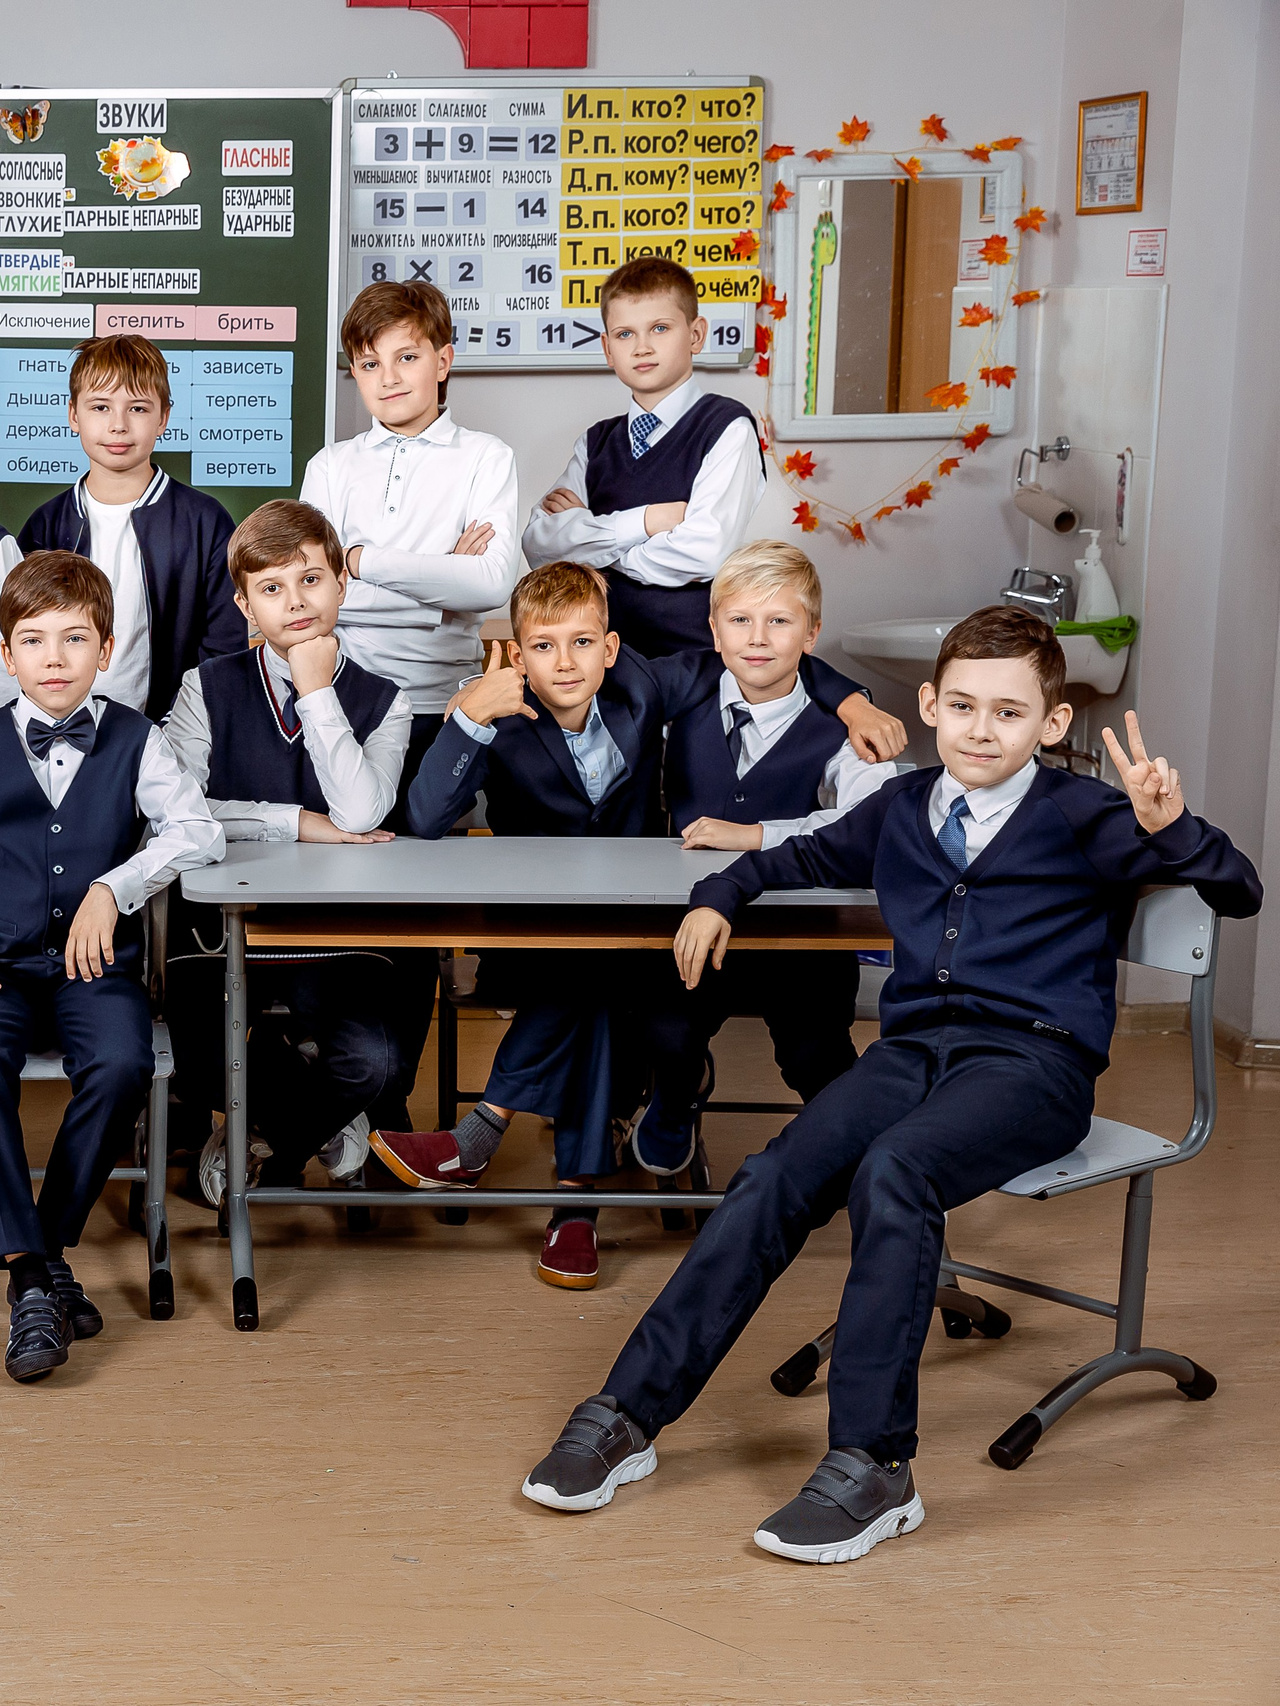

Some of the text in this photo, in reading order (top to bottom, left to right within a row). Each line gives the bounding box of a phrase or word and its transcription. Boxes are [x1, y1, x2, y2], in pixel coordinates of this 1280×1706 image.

[359, 102, 545, 118] СЛАГАЕМОЕ СЛАГАЕМОЕ СУММА
[567, 92, 756, 119] И.п. кто? что?
[99, 104, 164, 128] ЗВУКИ
[384, 134, 399, 153] 3
[528, 134, 556, 153] 12
[624, 130, 688, 154] кого?
[694, 129, 758, 153] чего?
[223, 147, 291, 168] ГЛАСНЫЕ
[0, 161, 63, 181] согласные
[354, 170, 552, 184] УМЕНЬШАЕМОЕ ВЫЧИТАЕМОЕ РАЗНОСТЬ
[568, 162, 759, 193] Д.п. кому? чему?
[225, 189, 291, 209] БЕЗУДАРНЫЕ
[376, 198, 404, 218] 15
[463, 198, 475, 217] 1
[518, 198, 547, 218] 14
[65, 208, 199, 227] ПАРНЫЕ НЕПАРНЫЕ
[226, 213, 292, 234] УДАРНЫЕ
[567, 200, 755, 229] В.п. кого? что?
[352, 233, 557, 249] МНОЖИТЕЛЬ МНОЖИТЕЛЬ ПРОИЗВЕДЕНИЕ
[625, 238, 687, 263] кем?
[64, 271, 198, 290] ПАРНЫЕ НЕПАРНЫЕ
[372, 263, 387, 281] 8
[458, 262, 474, 282] 2
[525, 264, 552, 284] 16
[709, 275, 760, 298] чём?
[447, 297, 549, 311] ИТЕЛЬ ЧАСТНОЕ
[108, 314, 185, 329] стелить
[218, 313, 274, 333] брить
[495, 327, 512, 347] 5
[542, 324, 565, 343] 11
[713, 325, 740, 346] 19
[19, 358, 67, 372] гнать
[203, 360, 283, 375] зависеть
[6, 393, 69, 408] дышат
[206, 394, 277, 409] терпеть
[5, 424, 80, 441] держать
[199, 428, 283, 444] смотреть
[7, 457, 79, 474] обидеть
[206, 462, 277, 478] вертеть
